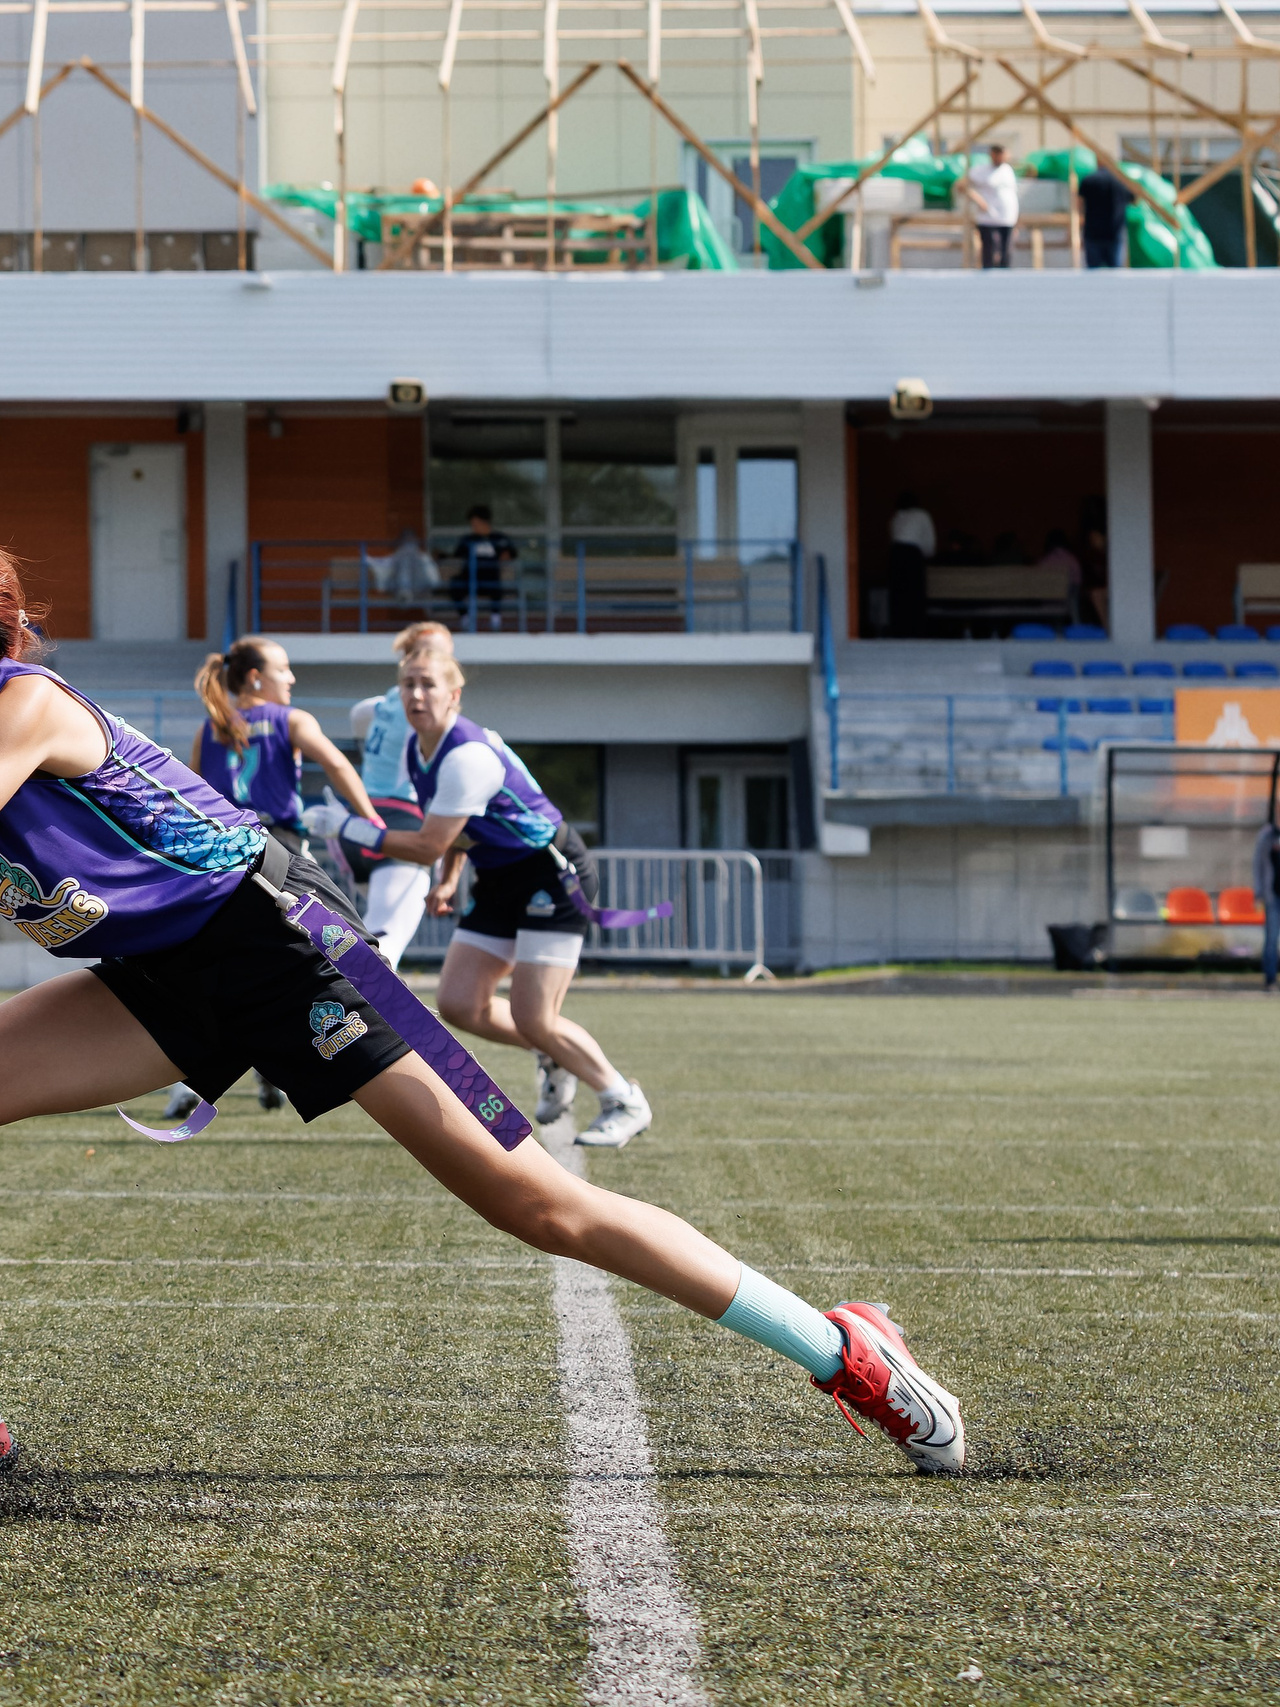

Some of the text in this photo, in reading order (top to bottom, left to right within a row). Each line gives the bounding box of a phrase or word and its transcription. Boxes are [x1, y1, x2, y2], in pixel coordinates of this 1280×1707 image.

[15, 893, 105, 947] UEENS
[319, 1020, 366, 1058] QUEENS
[478, 1094, 504, 1121] 66
